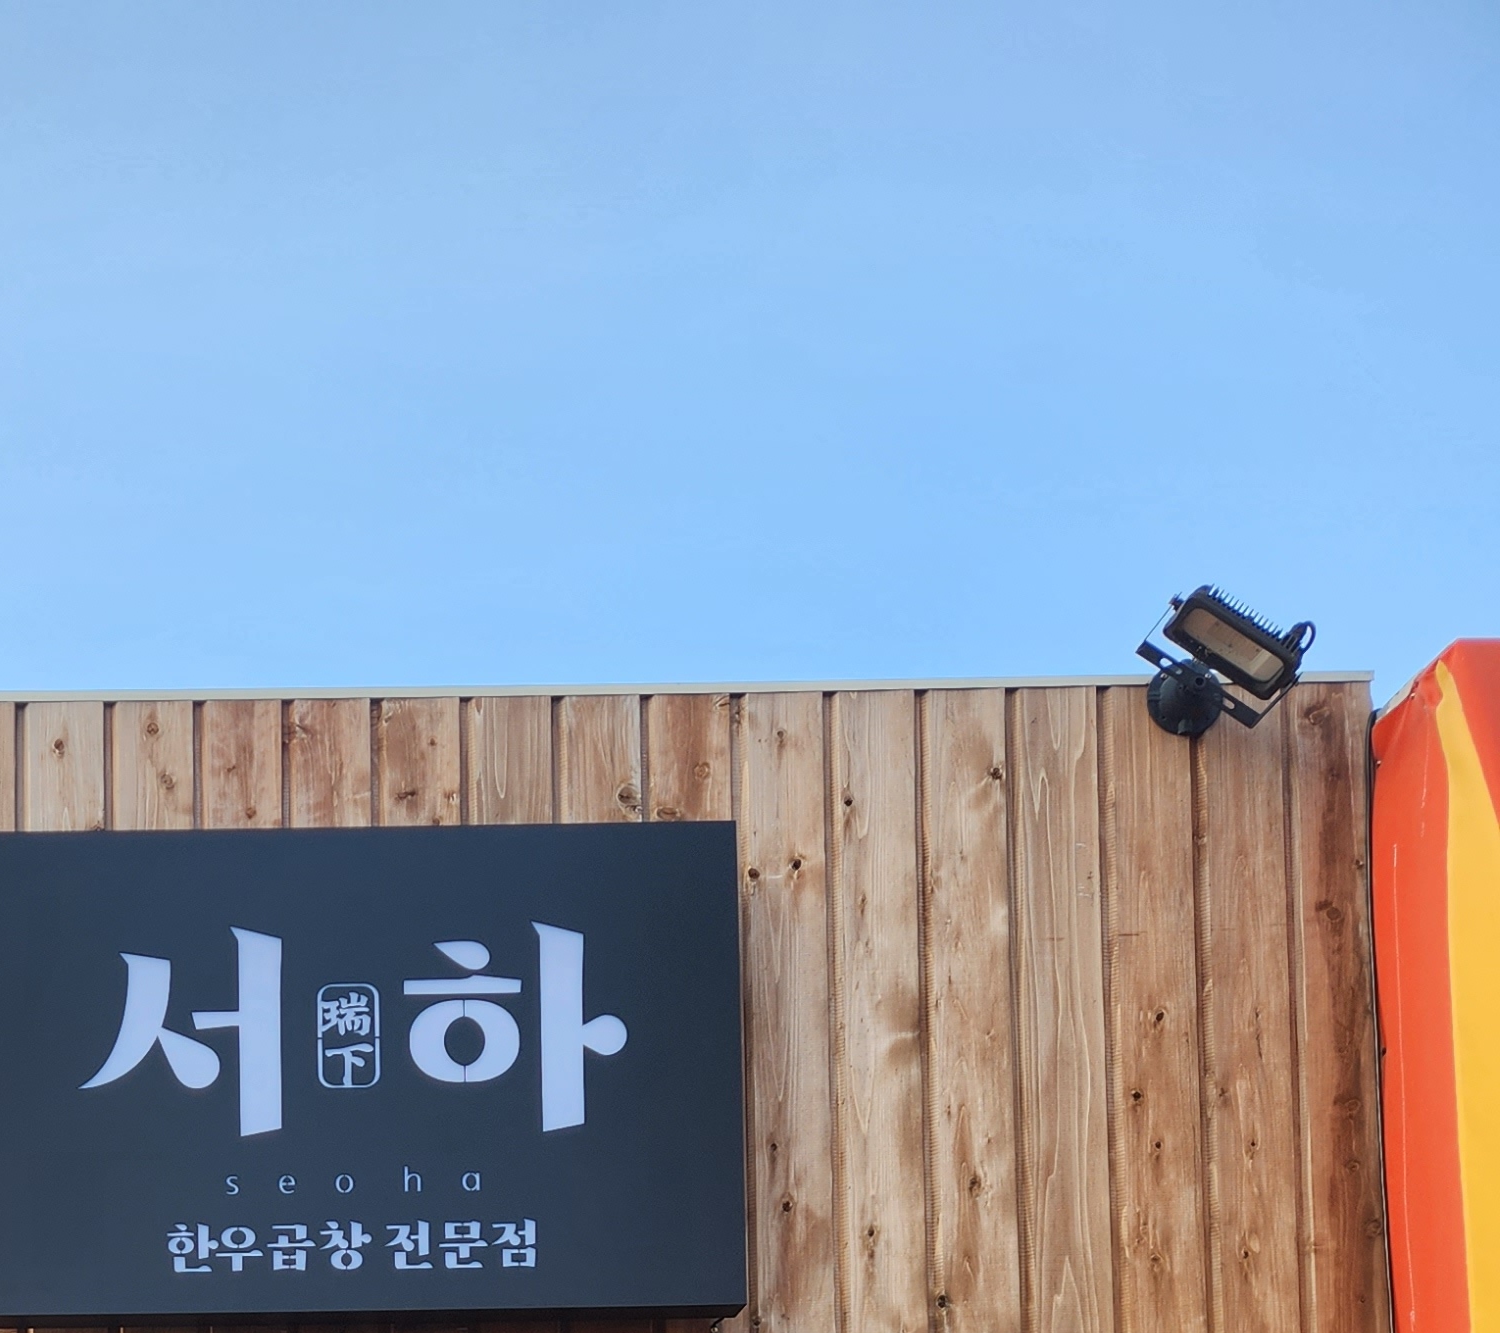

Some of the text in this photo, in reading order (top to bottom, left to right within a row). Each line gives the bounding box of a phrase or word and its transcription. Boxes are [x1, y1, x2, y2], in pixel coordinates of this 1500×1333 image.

[322, 990, 372, 1087] 瑞下
[225, 1166, 482, 1196] seoha
[166, 1218, 538, 1275] 한우곱창 전문점
